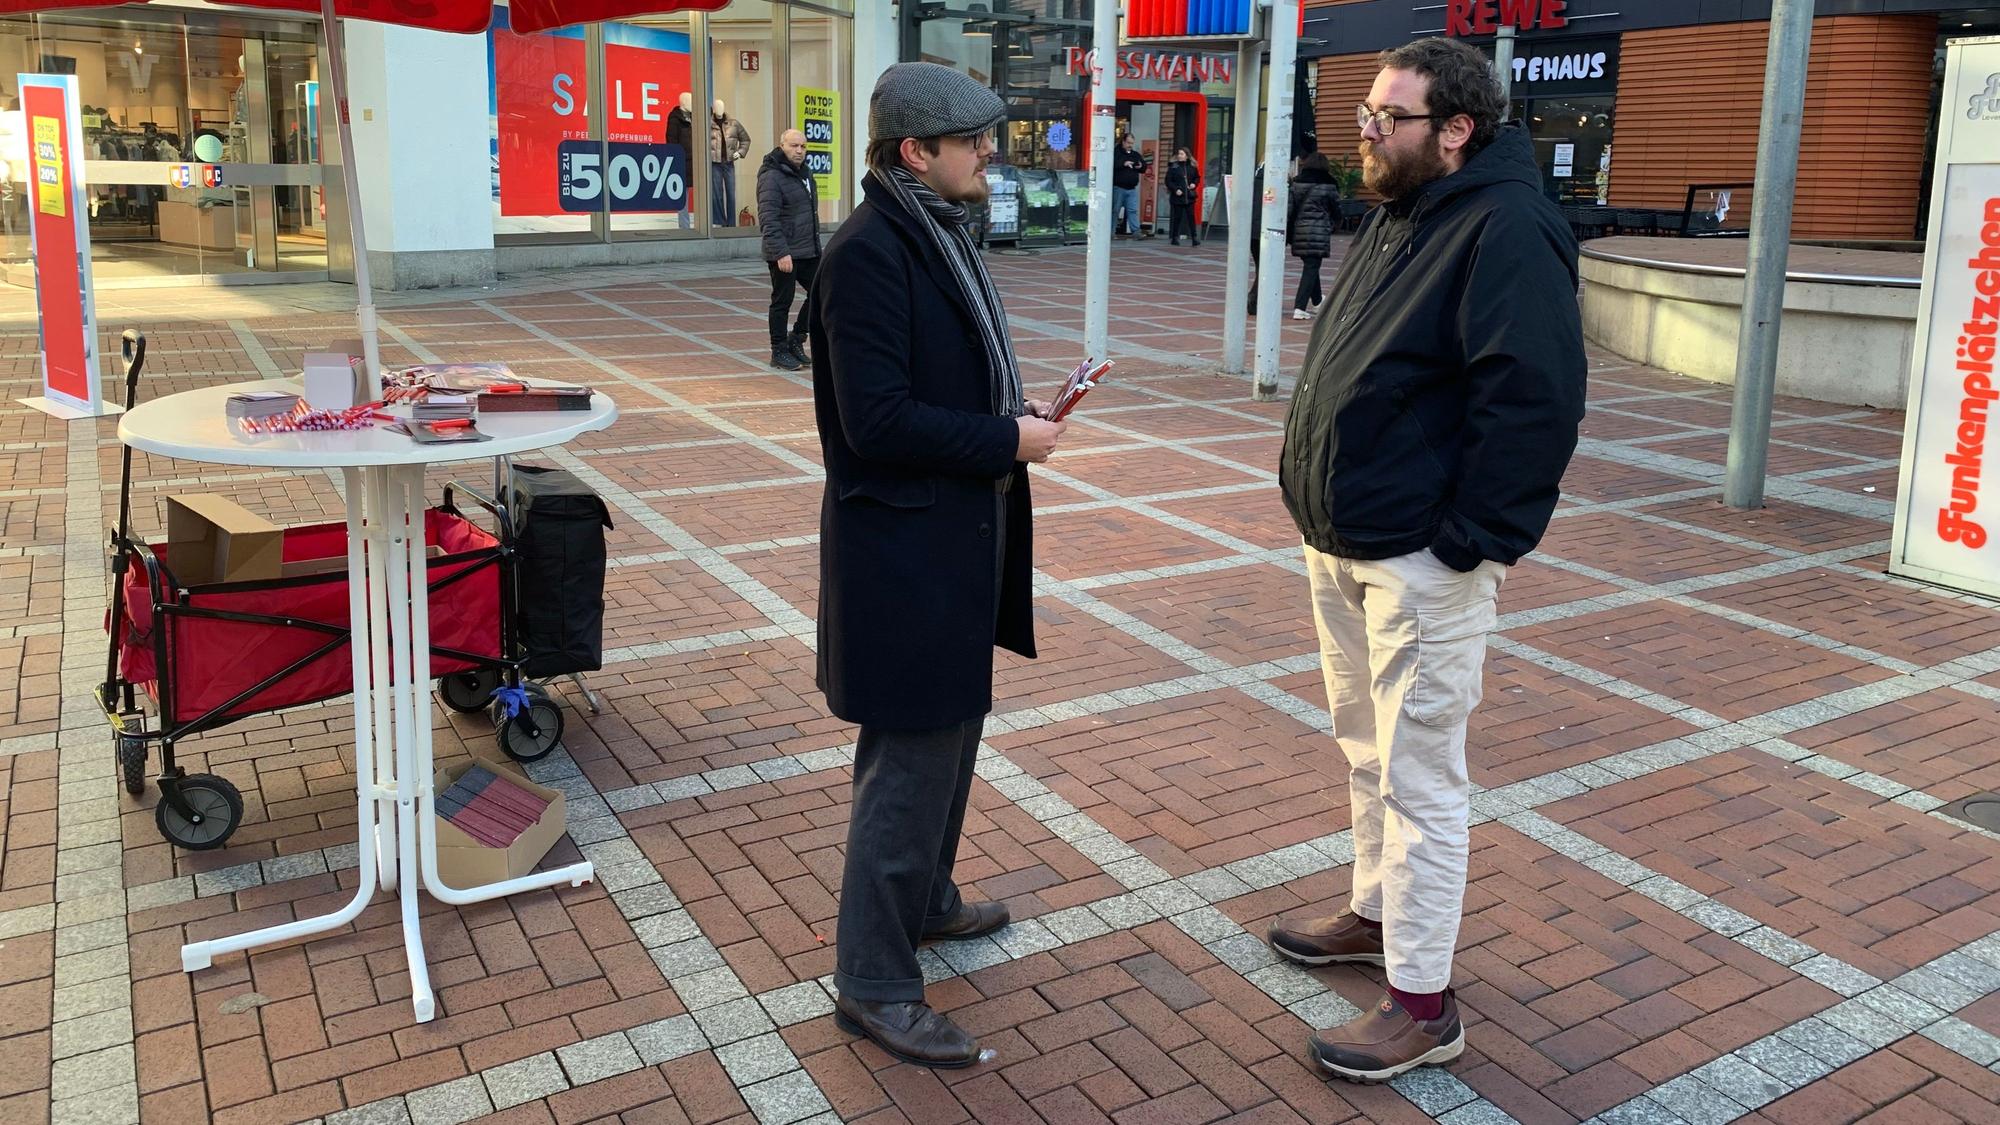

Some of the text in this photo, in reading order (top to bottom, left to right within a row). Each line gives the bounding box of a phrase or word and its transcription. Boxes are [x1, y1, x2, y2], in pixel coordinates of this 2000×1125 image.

[1445, 0, 1569, 36] REWE
[1512, 52, 1607, 82] TEHAUS
[552, 73, 661, 121] SLE
[804, 95, 833, 107] ON TOP
[804, 107, 833, 118] AUF SALE
[575, 131, 588, 139] PEE
[607, 132, 653, 143] OPPENBURG
[806, 122, 832, 140] 30%
[807, 154, 832, 171] 20%
[40, 167, 57, 183] 20%
[571, 153, 684, 200] 50%
[1937, 198, 2000, 549] Funkenplätzchen
